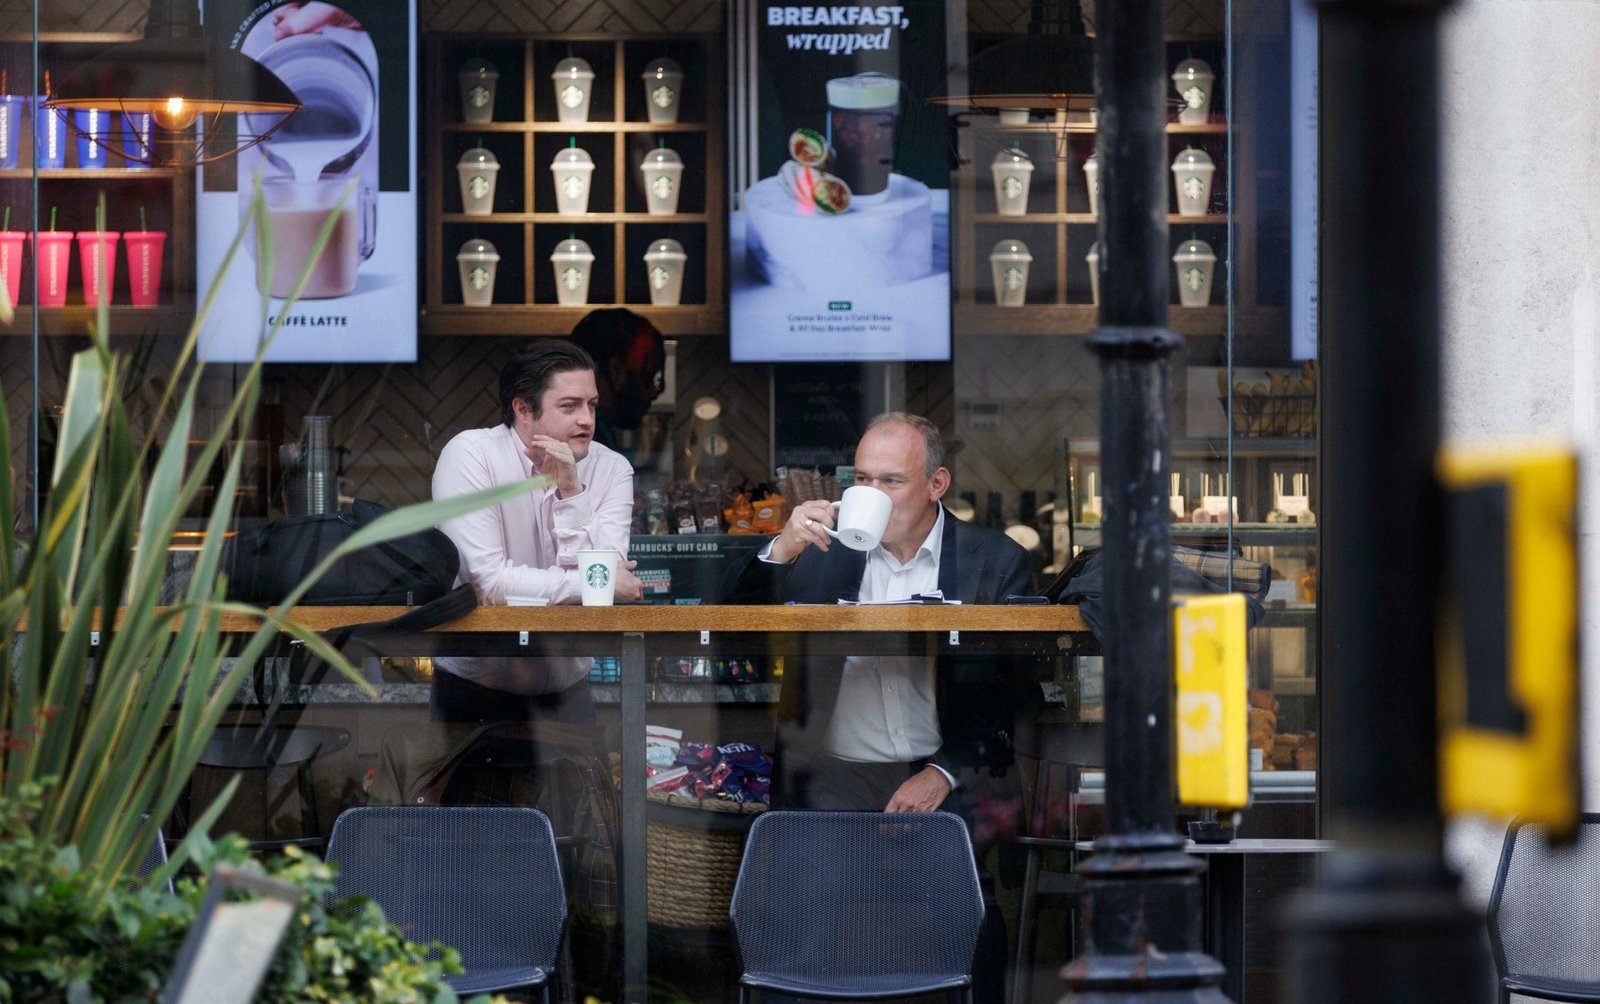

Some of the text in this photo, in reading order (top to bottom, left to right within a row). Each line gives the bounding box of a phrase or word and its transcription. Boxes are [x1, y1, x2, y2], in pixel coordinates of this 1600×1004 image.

[766, 6, 910, 30] BREAKFAST,
[786, 27, 892, 55] wrapped
[50, 243, 58, 296] STARBUCKS
[310, 315, 348, 326] LATTE
[676, 543, 694, 552] GIFT
[696, 543, 718, 552] CARD
